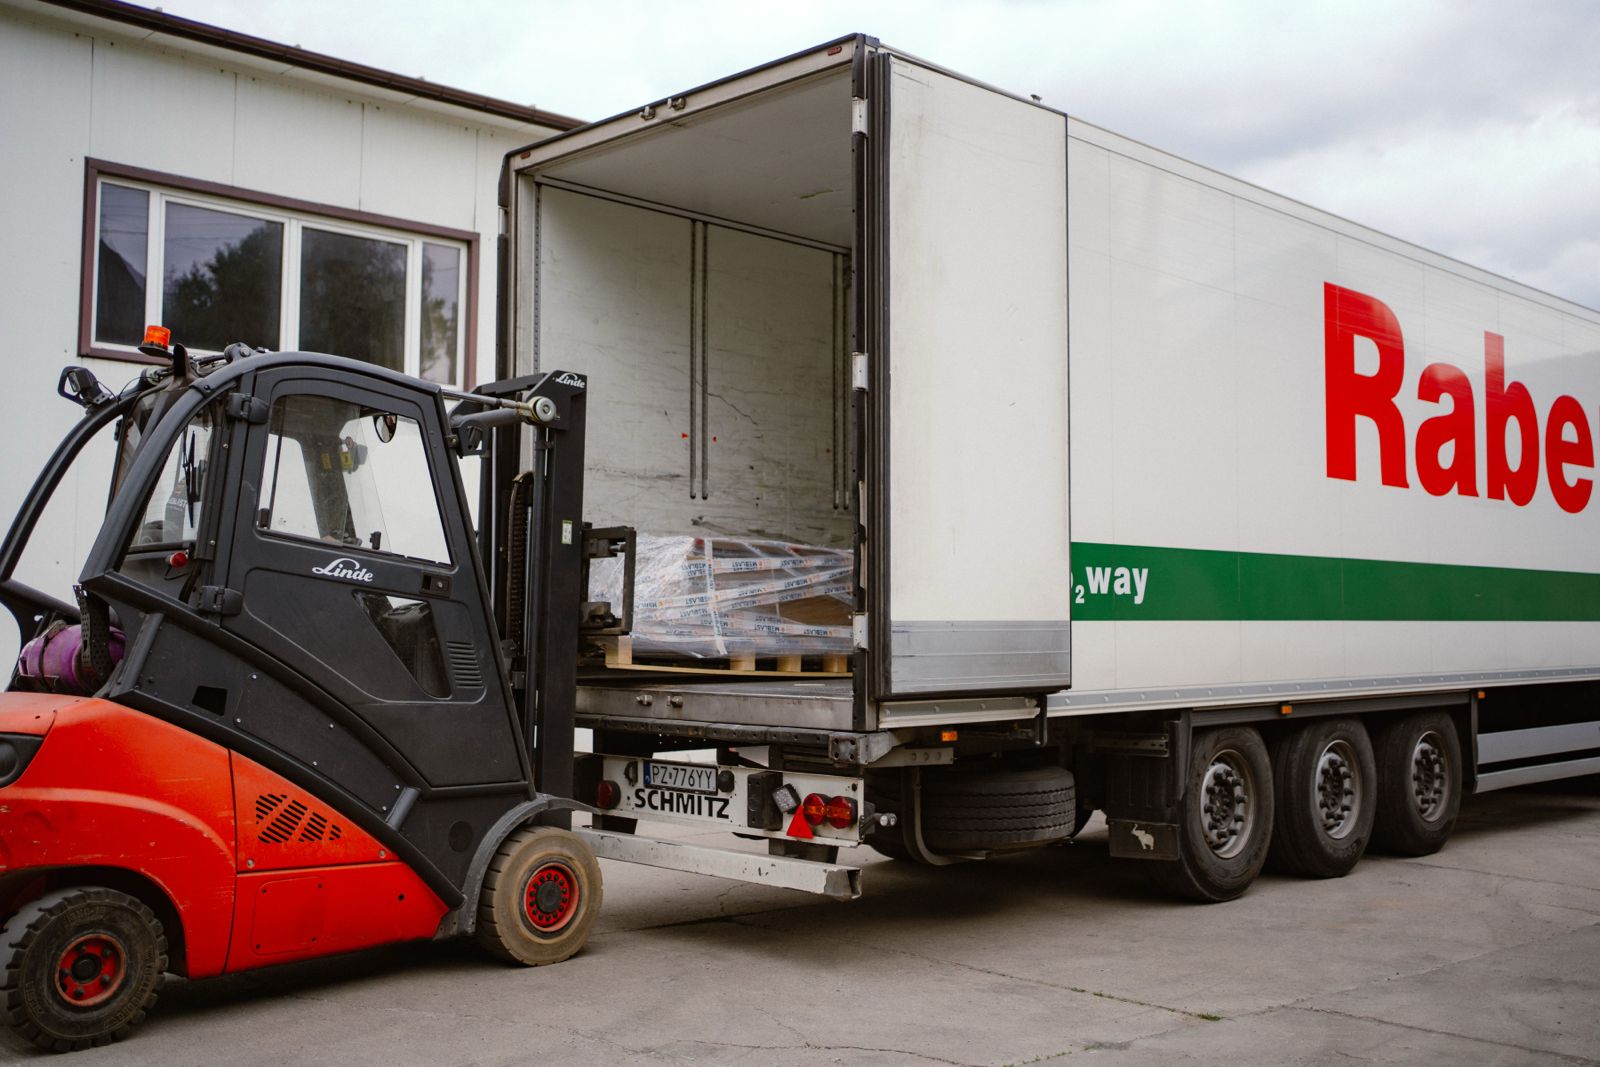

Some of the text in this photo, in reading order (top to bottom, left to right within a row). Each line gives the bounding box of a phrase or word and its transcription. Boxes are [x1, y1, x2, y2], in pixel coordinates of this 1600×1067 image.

[552, 372, 586, 389] Linde
[1324, 281, 1600, 514] Rabe
[312, 557, 374, 582] Linde
[1071, 566, 1149, 605] 2way
[672, 767, 713, 790] 776YY
[634, 788, 730, 820] SCHMITZ
